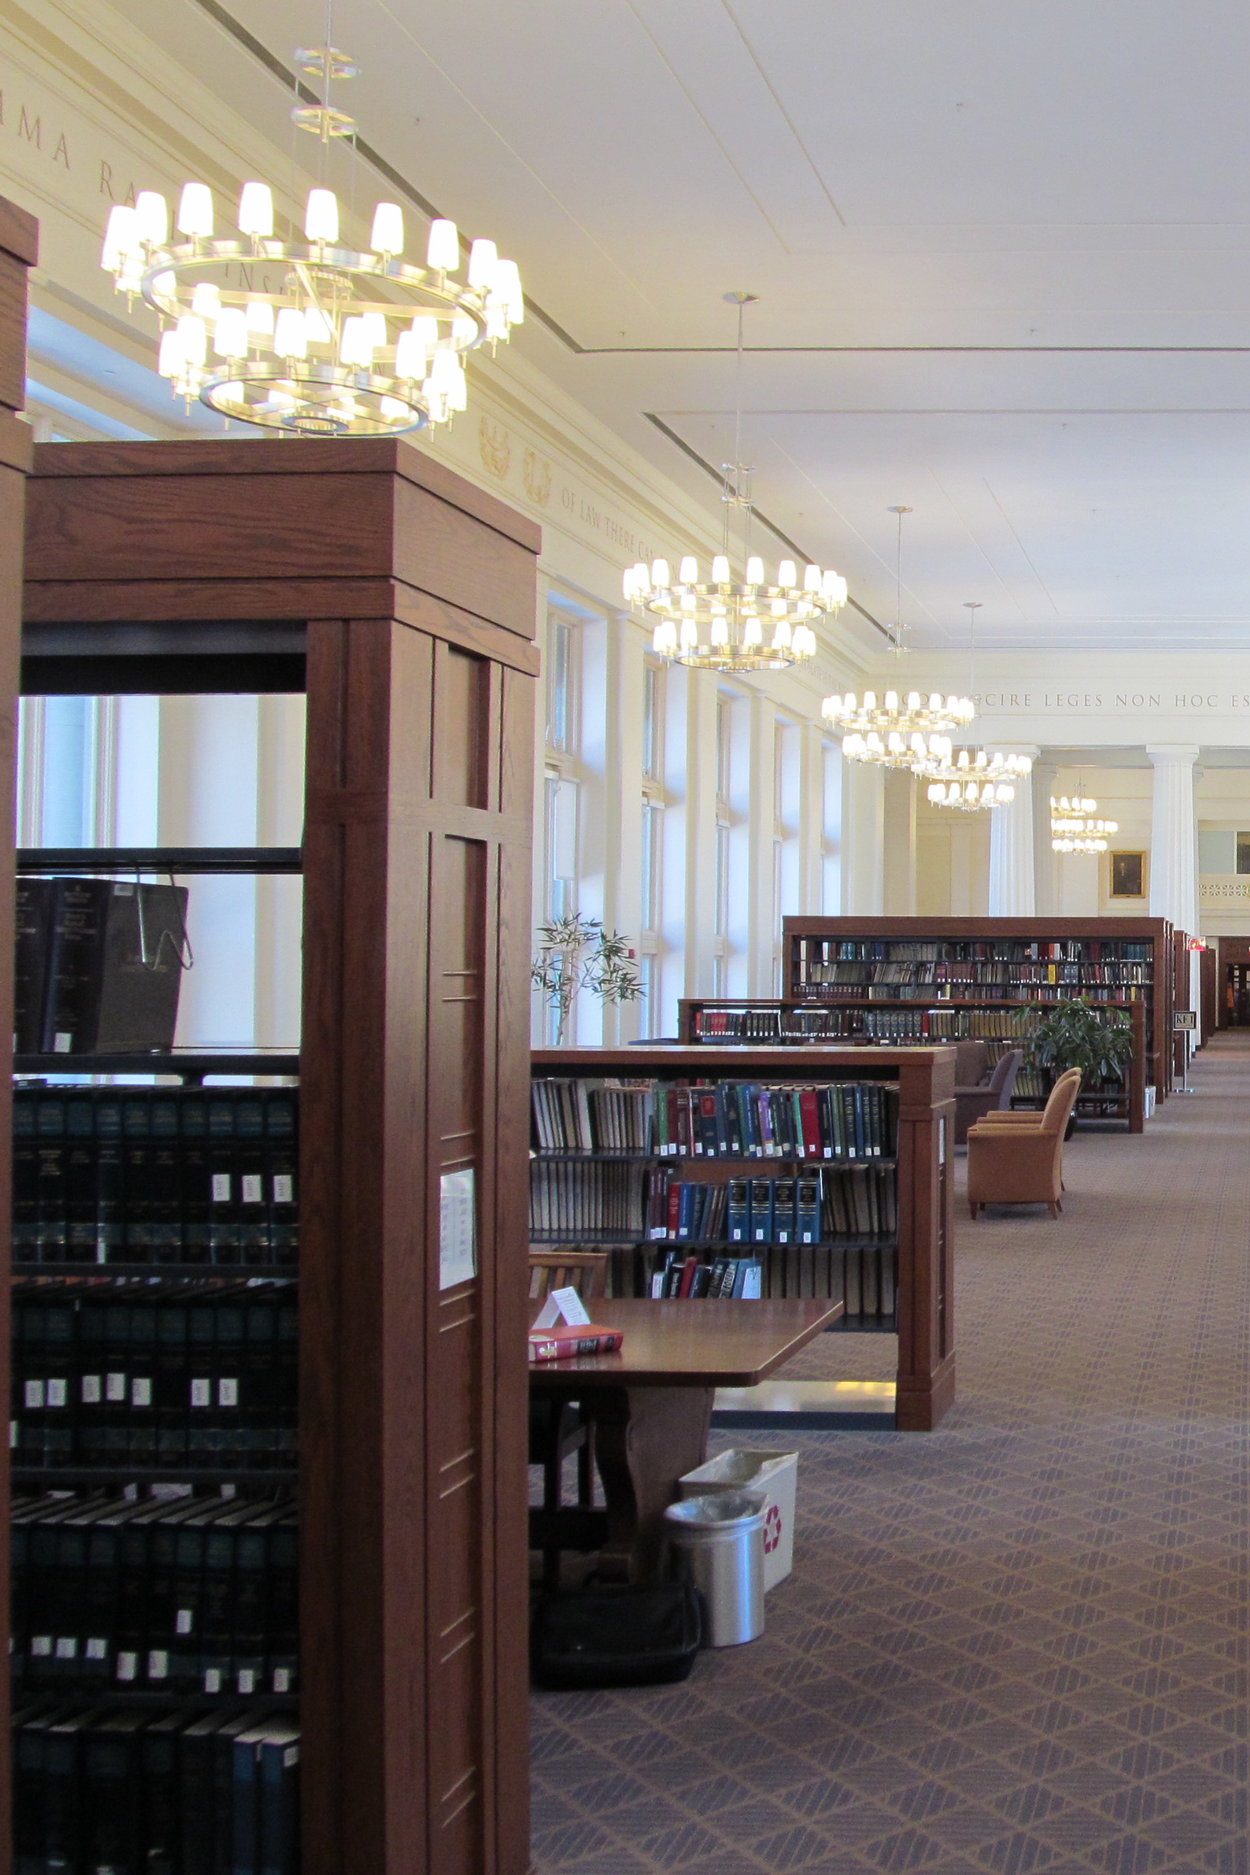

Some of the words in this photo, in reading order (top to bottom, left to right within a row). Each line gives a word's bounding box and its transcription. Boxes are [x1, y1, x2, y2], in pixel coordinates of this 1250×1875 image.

[1044, 693, 1103, 707] LEGES
[1115, 693, 1162, 708] NON
[1174, 694, 1219, 708] HOC
[1176, 1014, 1186, 1024] KF
